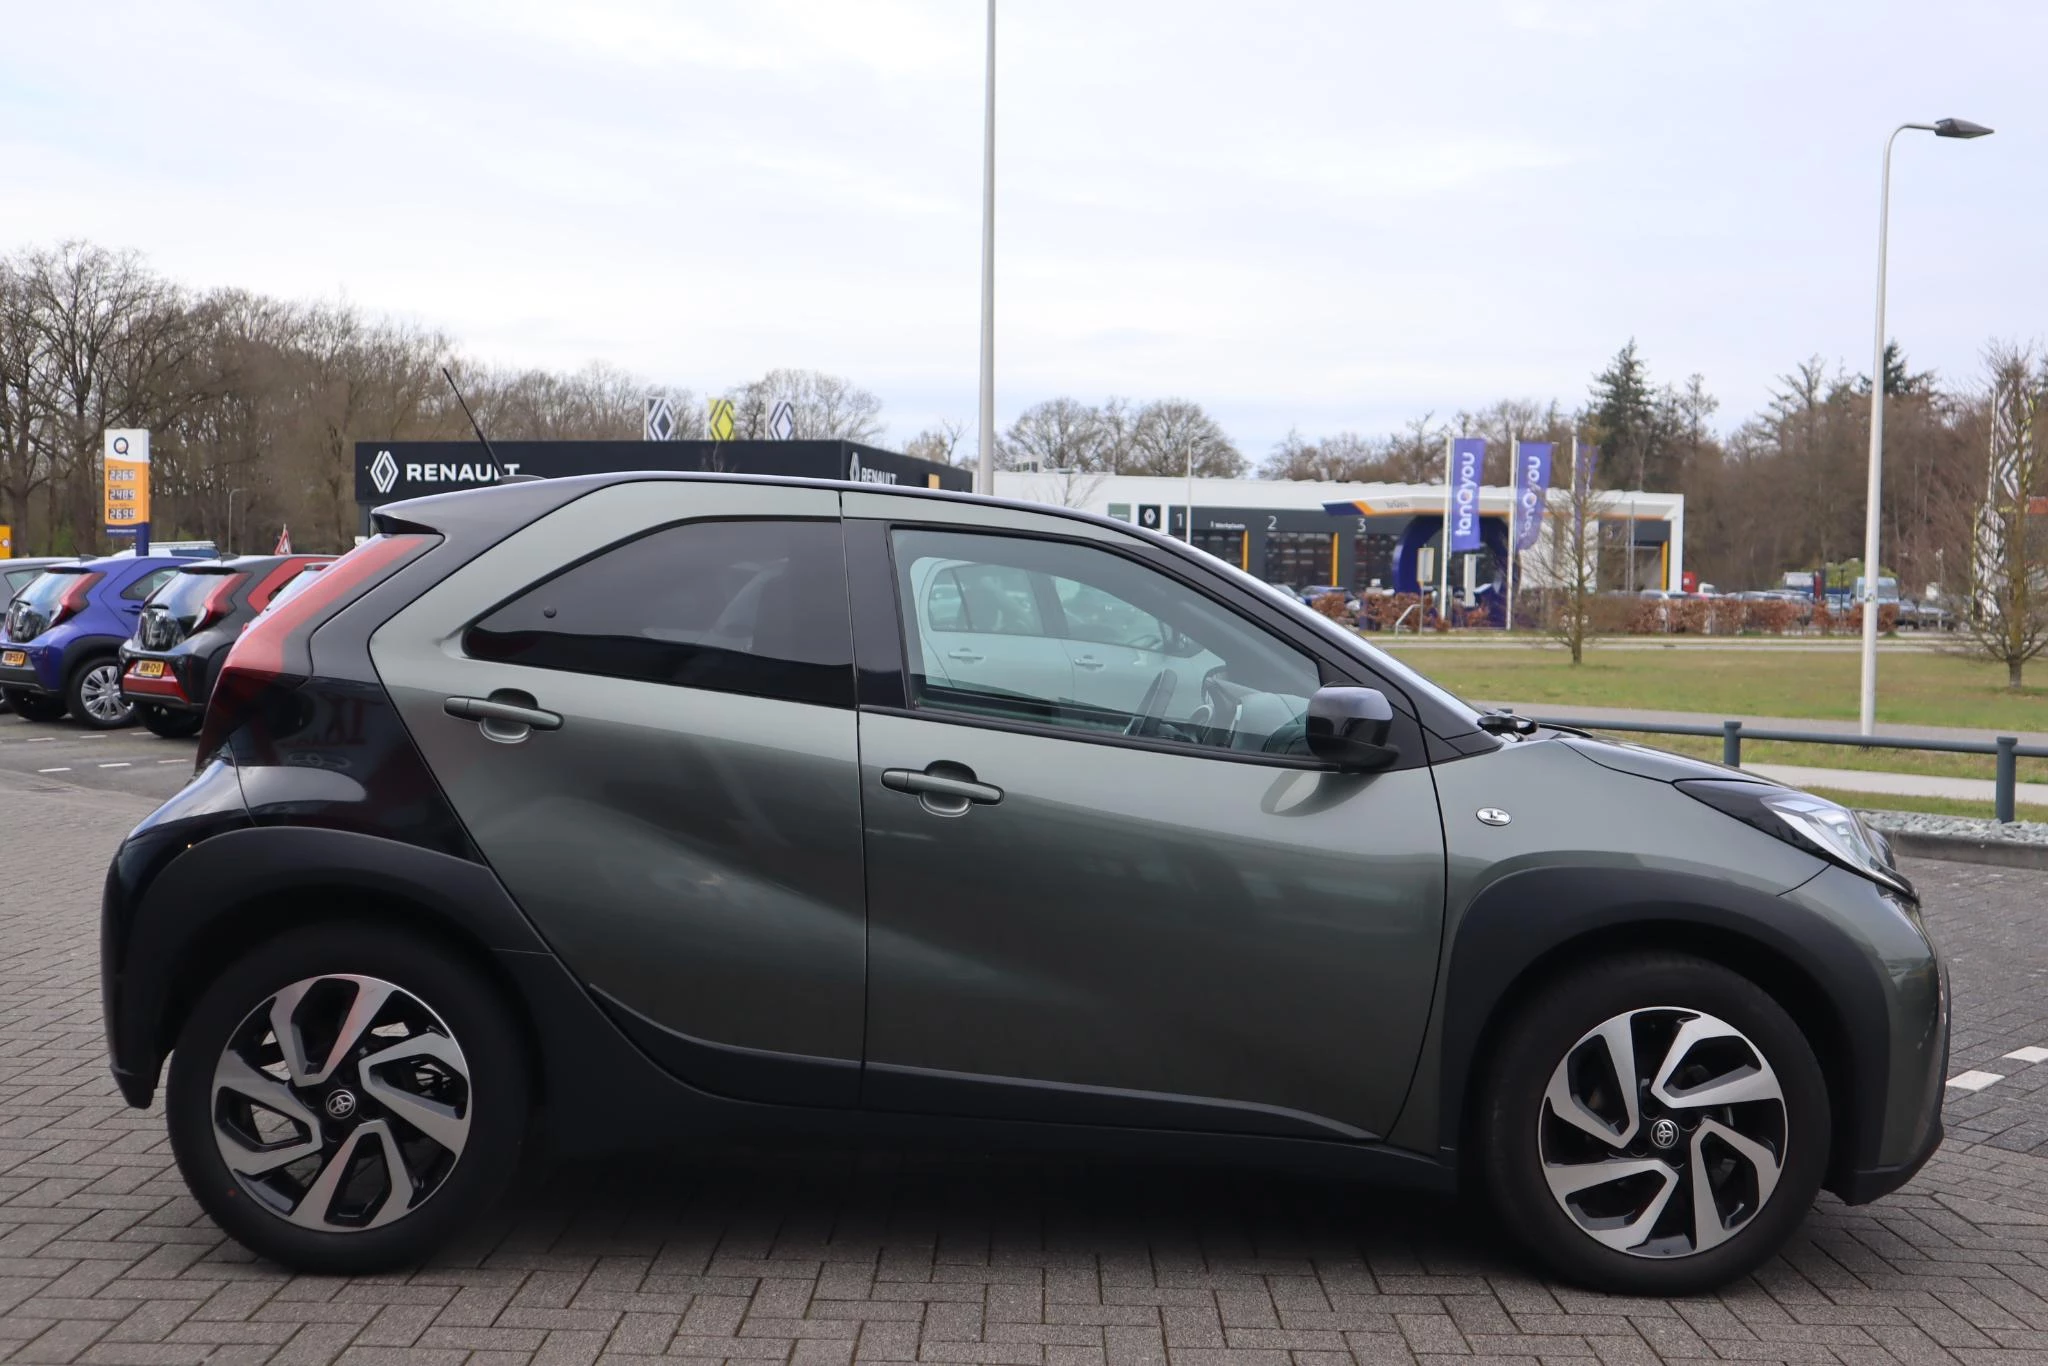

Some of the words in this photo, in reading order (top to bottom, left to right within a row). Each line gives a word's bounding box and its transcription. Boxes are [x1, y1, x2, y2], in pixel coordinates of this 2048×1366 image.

[113, 437, 129, 456] Q
[1456, 452, 1478, 536] tanQyou
[1176, 513, 1183, 527] 1
[1267, 515, 1277, 530] 2
[1357, 518, 1366, 532] 3
